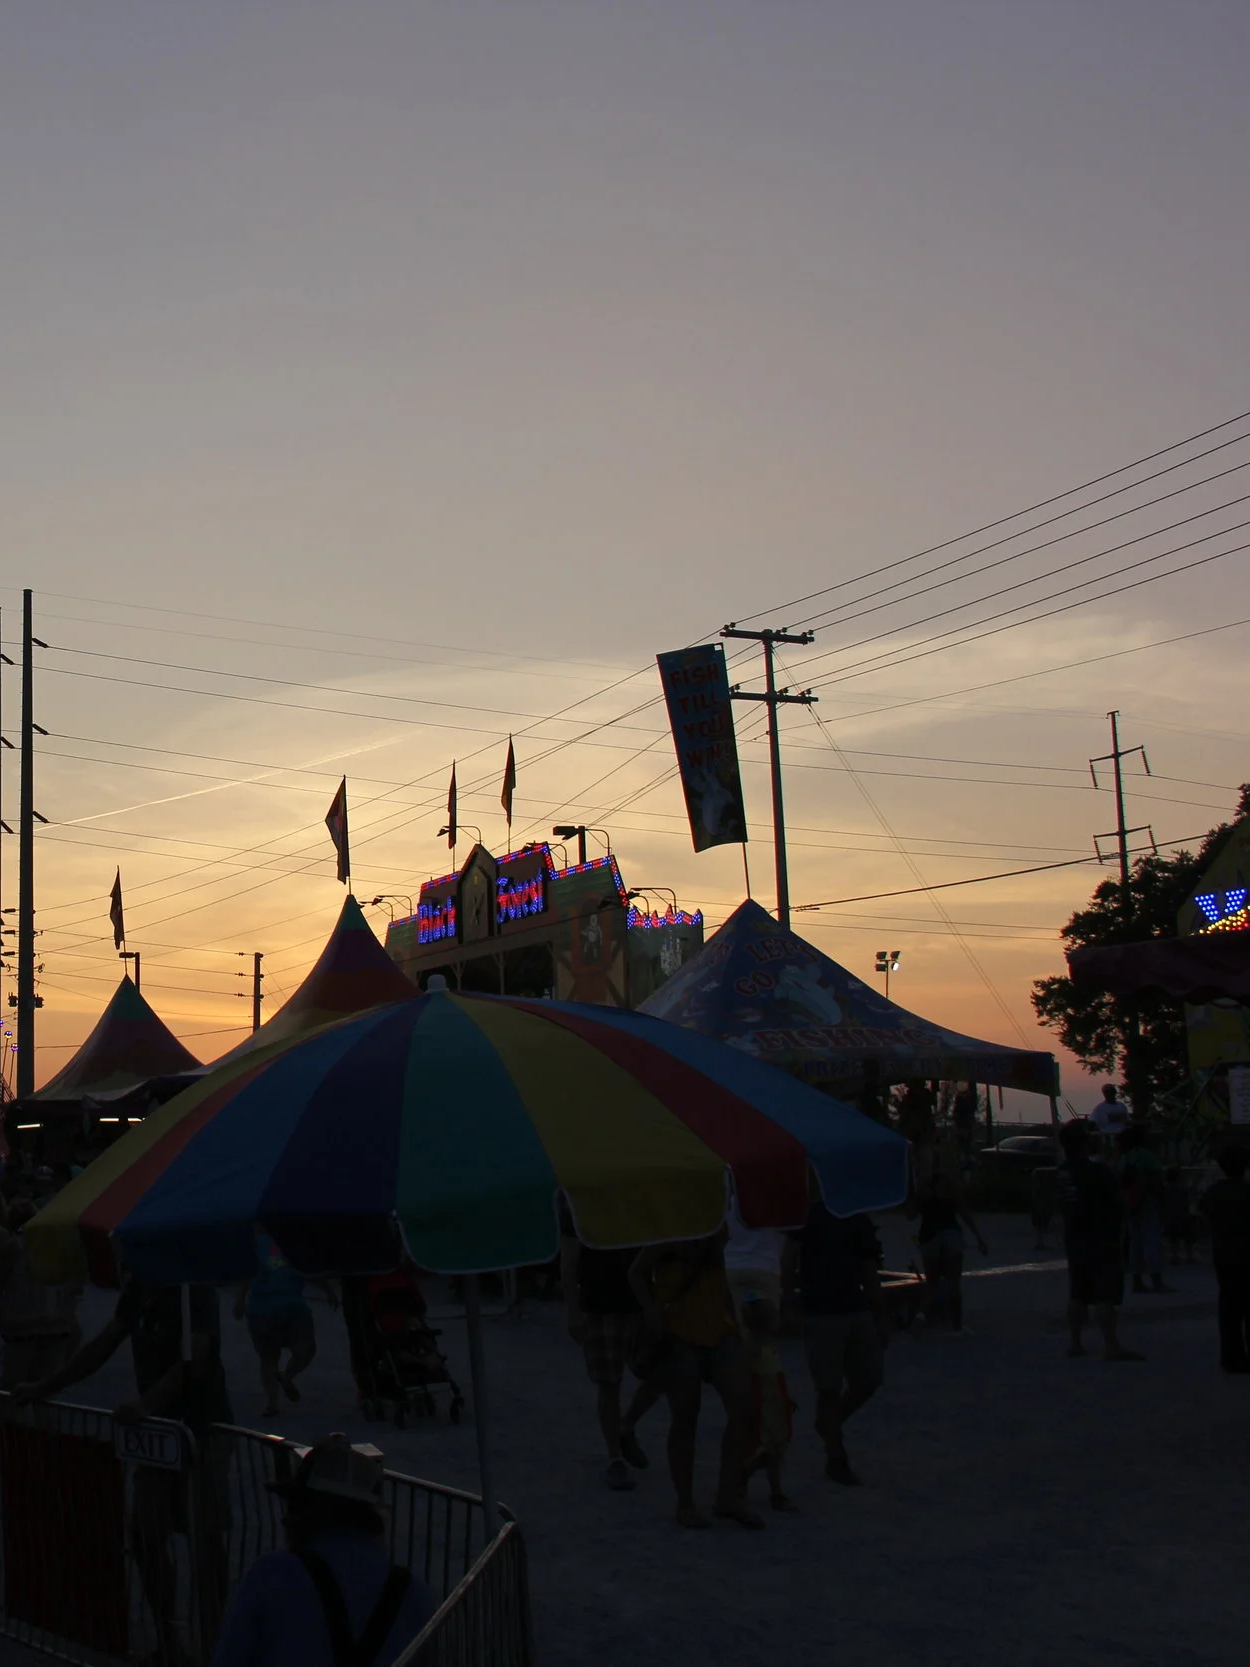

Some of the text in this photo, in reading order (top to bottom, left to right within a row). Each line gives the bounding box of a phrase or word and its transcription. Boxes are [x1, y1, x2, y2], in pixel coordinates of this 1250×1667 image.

[670, 663, 719, 690] FISH
[677, 690, 722, 715] TILL
[682, 711, 725, 740] YOU
[733, 970, 776, 997] GO
[750, 1027, 938, 1050] FISHING
[125, 1430, 168, 1458] EXIT
